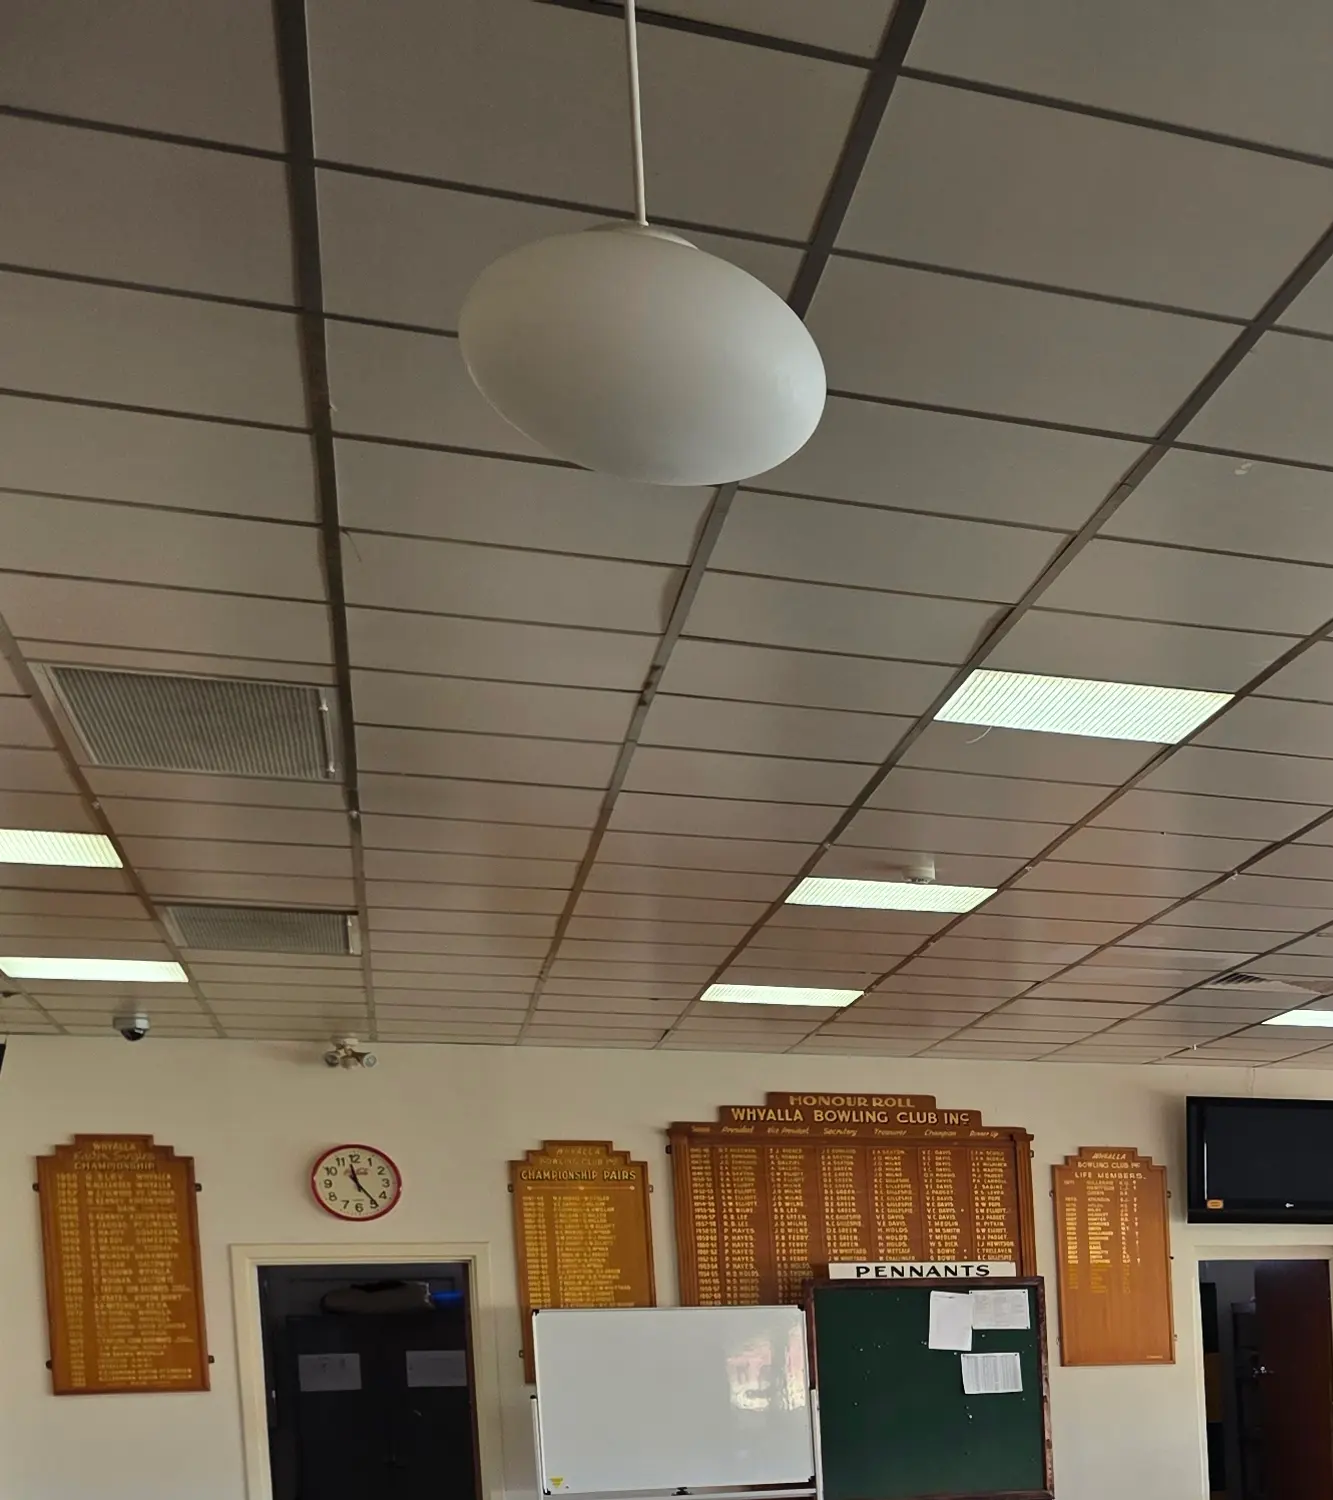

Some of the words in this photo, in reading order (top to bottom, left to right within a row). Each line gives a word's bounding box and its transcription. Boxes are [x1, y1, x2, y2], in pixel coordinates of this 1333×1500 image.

[789, 1096, 869, 1107] HONOUR
[872, 1098, 915, 1108] ROLL
[732, 1108, 804, 1122] WHYALLA
[814, 1110, 888, 1124] BOWLING
[896, 1112, 938, 1124] CLUB
[336, 1157, 346, 1166] 11
[348, 1154, 360, 1164] 12
[368, 1158, 372, 1167] 1
[74, 1162, 155, 1170] CHAMPIONSHIP
[324, 1166, 338, 1176] 10
[377, 1166, 386, 1176] 2
[521, 1170, 598, 1180] CHAMPIONSHIP
[604, 1170, 636, 1180] PAIRS
[324, 1178, 332, 1188] 9
[382, 1178, 390, 1188] 3
[328, 1192, 338, 1202] 8
[378, 1190, 387, 1200] 4
[340, 1200, 350, 1210] 7
[354, 1202, 364, 1212] 6
[856, 1264, 990, 1278] PENNANTS
